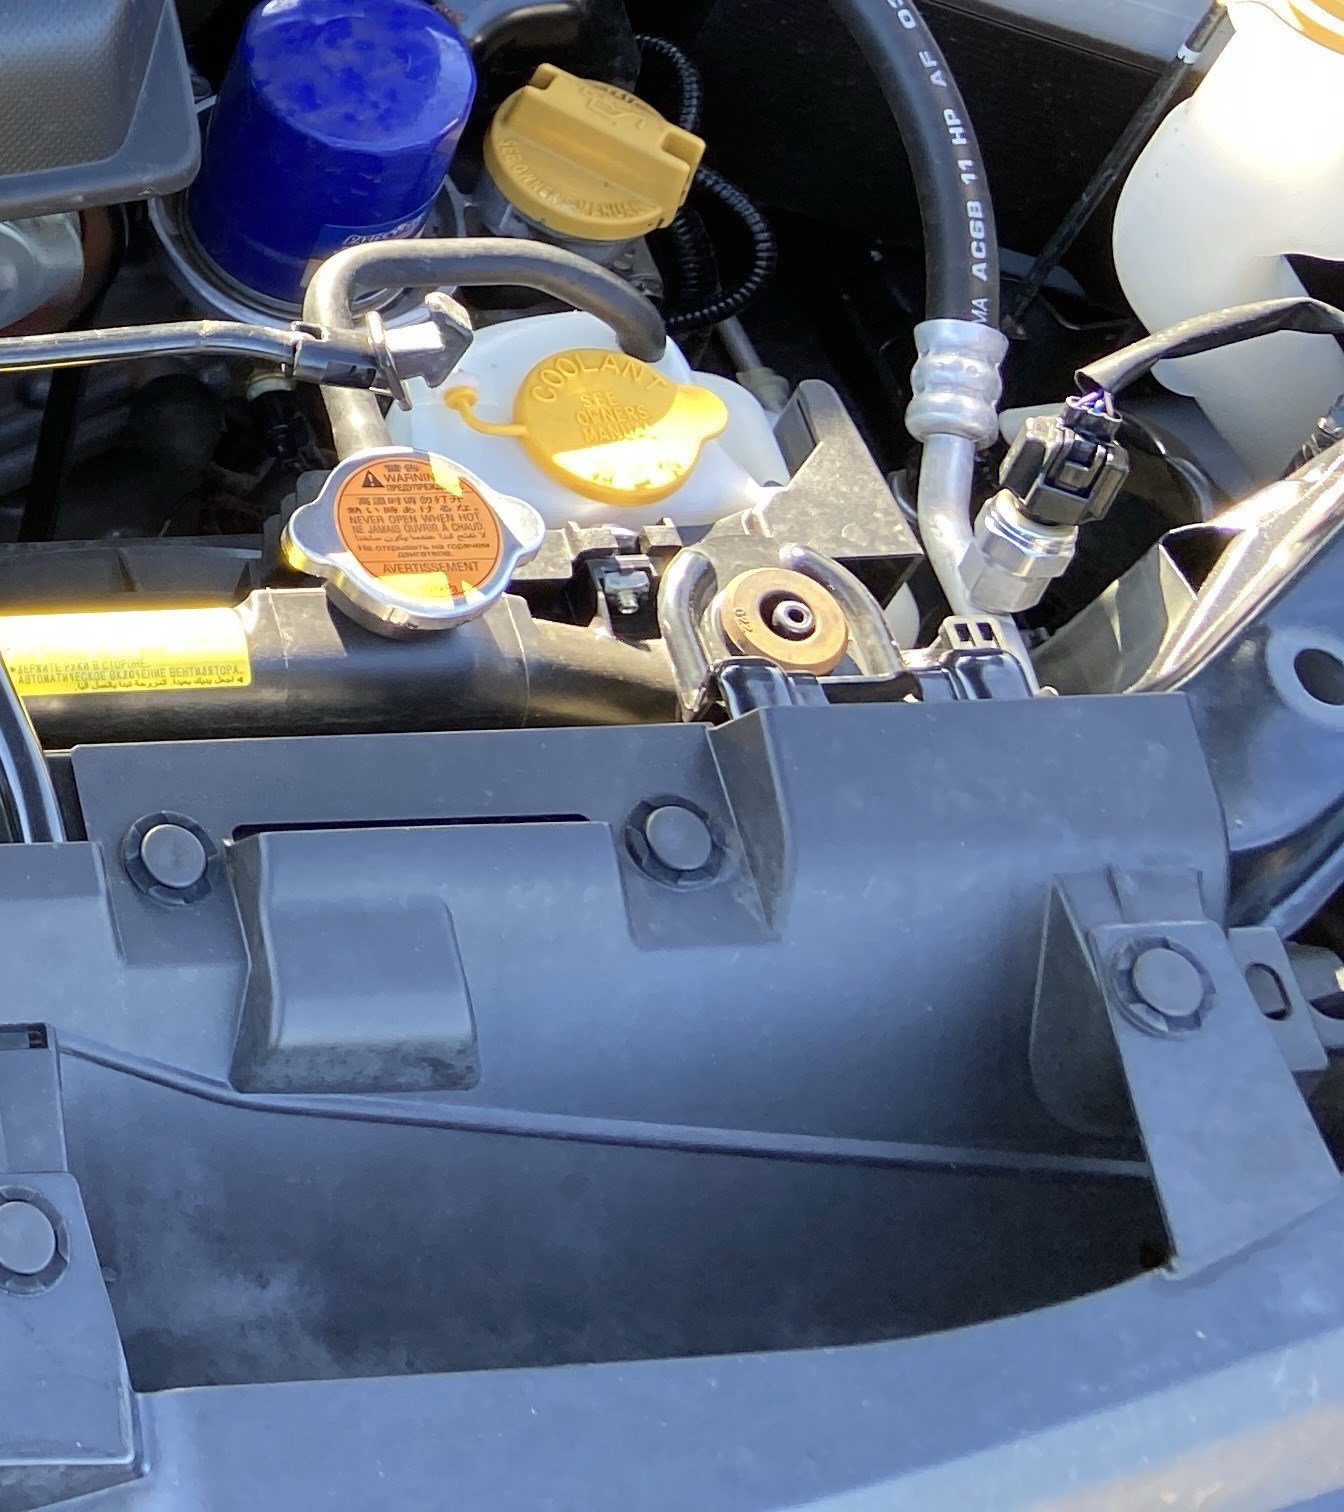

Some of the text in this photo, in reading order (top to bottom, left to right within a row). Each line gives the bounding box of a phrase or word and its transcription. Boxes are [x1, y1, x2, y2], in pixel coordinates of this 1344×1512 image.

[918, 50, 947, 87] AF
[943, 108, 967, 145] HP
[957, 158, 978, 185] 11
[531, 354, 667, 403] COOLANT
[579, 390, 617, 408] SEE
[577, 405, 648, 426] OWNERS
[384, 473, 436, 483] WARNIN
[349, 513, 480, 524] NEVER OPEN WHEN HOT
[368, 525, 401, 533] JAMAIS
[405, 524, 438, 533] OUVRIR
[383, 561, 479, 573] AVERTISSEMENT
[18, 671, 107, 684] АВТОМАТИЧЕСКОЕ
[109, 668, 166, 680] ВКЛЮЧЕНИЕ
